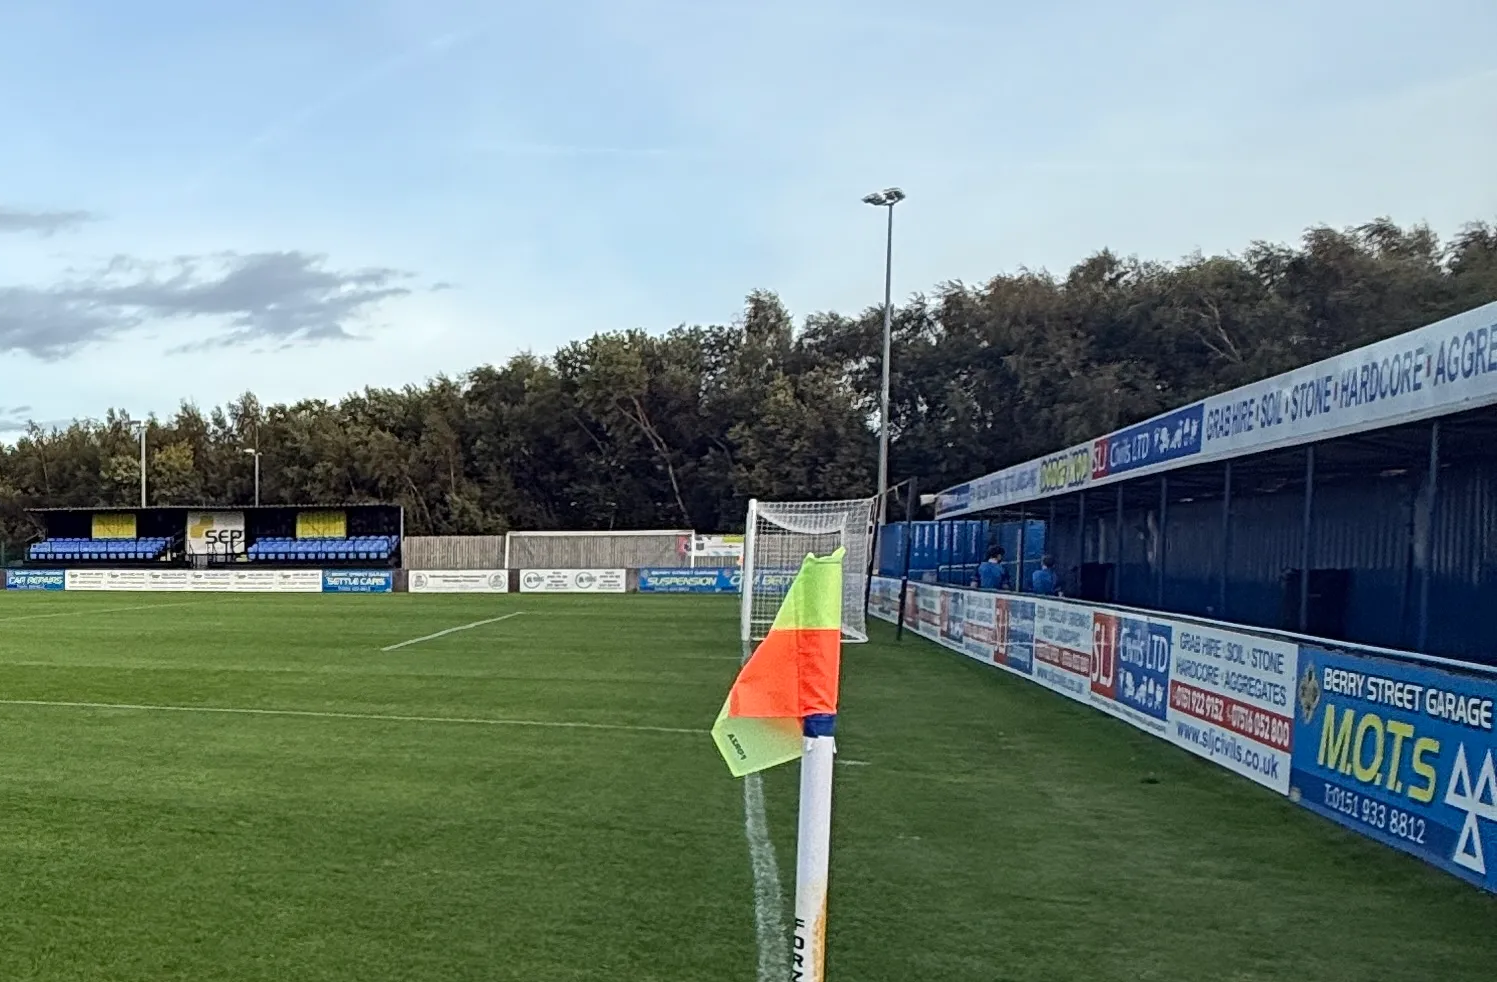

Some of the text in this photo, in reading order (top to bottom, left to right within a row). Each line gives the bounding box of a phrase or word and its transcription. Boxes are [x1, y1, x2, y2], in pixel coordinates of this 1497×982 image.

[1207, 407, 1230, 441] GRAB
[1231, 399, 1254, 436] HIRE
[1260, 391, 1282, 428] SOIL
[1291, 375, 1332, 421] STONE
[1339, 347, 1424, 408] HARDCORE
[1132, 433, 1149, 462] LTD
[647, 576, 717, 586] SUSPENSION
[1146, 634, 1168, 673] LTD
[1226, 641, 1245, 665] SOIL
[1252, 648, 1284, 674] STONE
[1224, 670, 1286, 706] AGGREGATES
[1324, 667, 1493, 729] BERRY STREET GARAGE
[1176, 720, 1279, 779] www.sljcivils.co.uk
[1271, 717, 1289, 747] 800
[1362, 798, 1386, 829] 933
[1389, 809, 1425, 844] 8812
